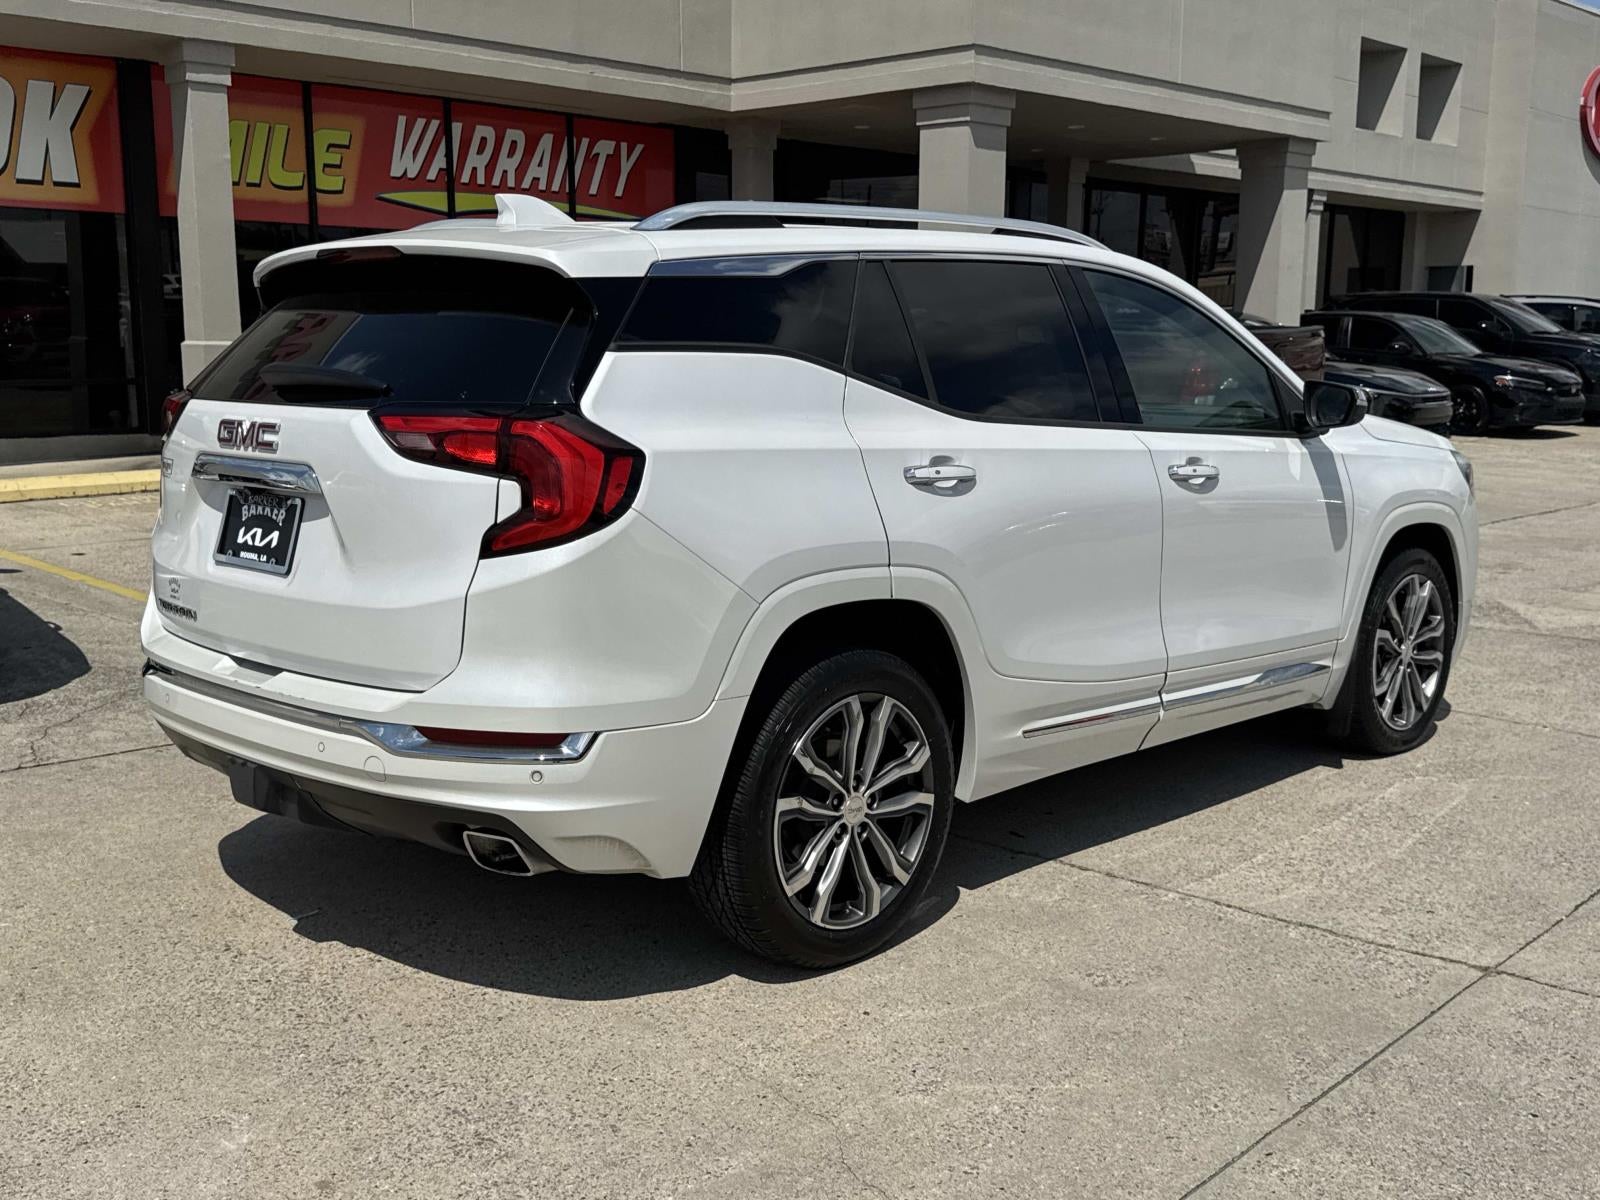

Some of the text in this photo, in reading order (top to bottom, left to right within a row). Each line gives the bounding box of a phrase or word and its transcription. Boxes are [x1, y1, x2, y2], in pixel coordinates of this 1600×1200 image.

[0, 77, 91, 187] K
[389, 115, 645, 197] WARRANTY
[217, 418, 281, 454] GMC
[236, 526, 280, 549] KIA
